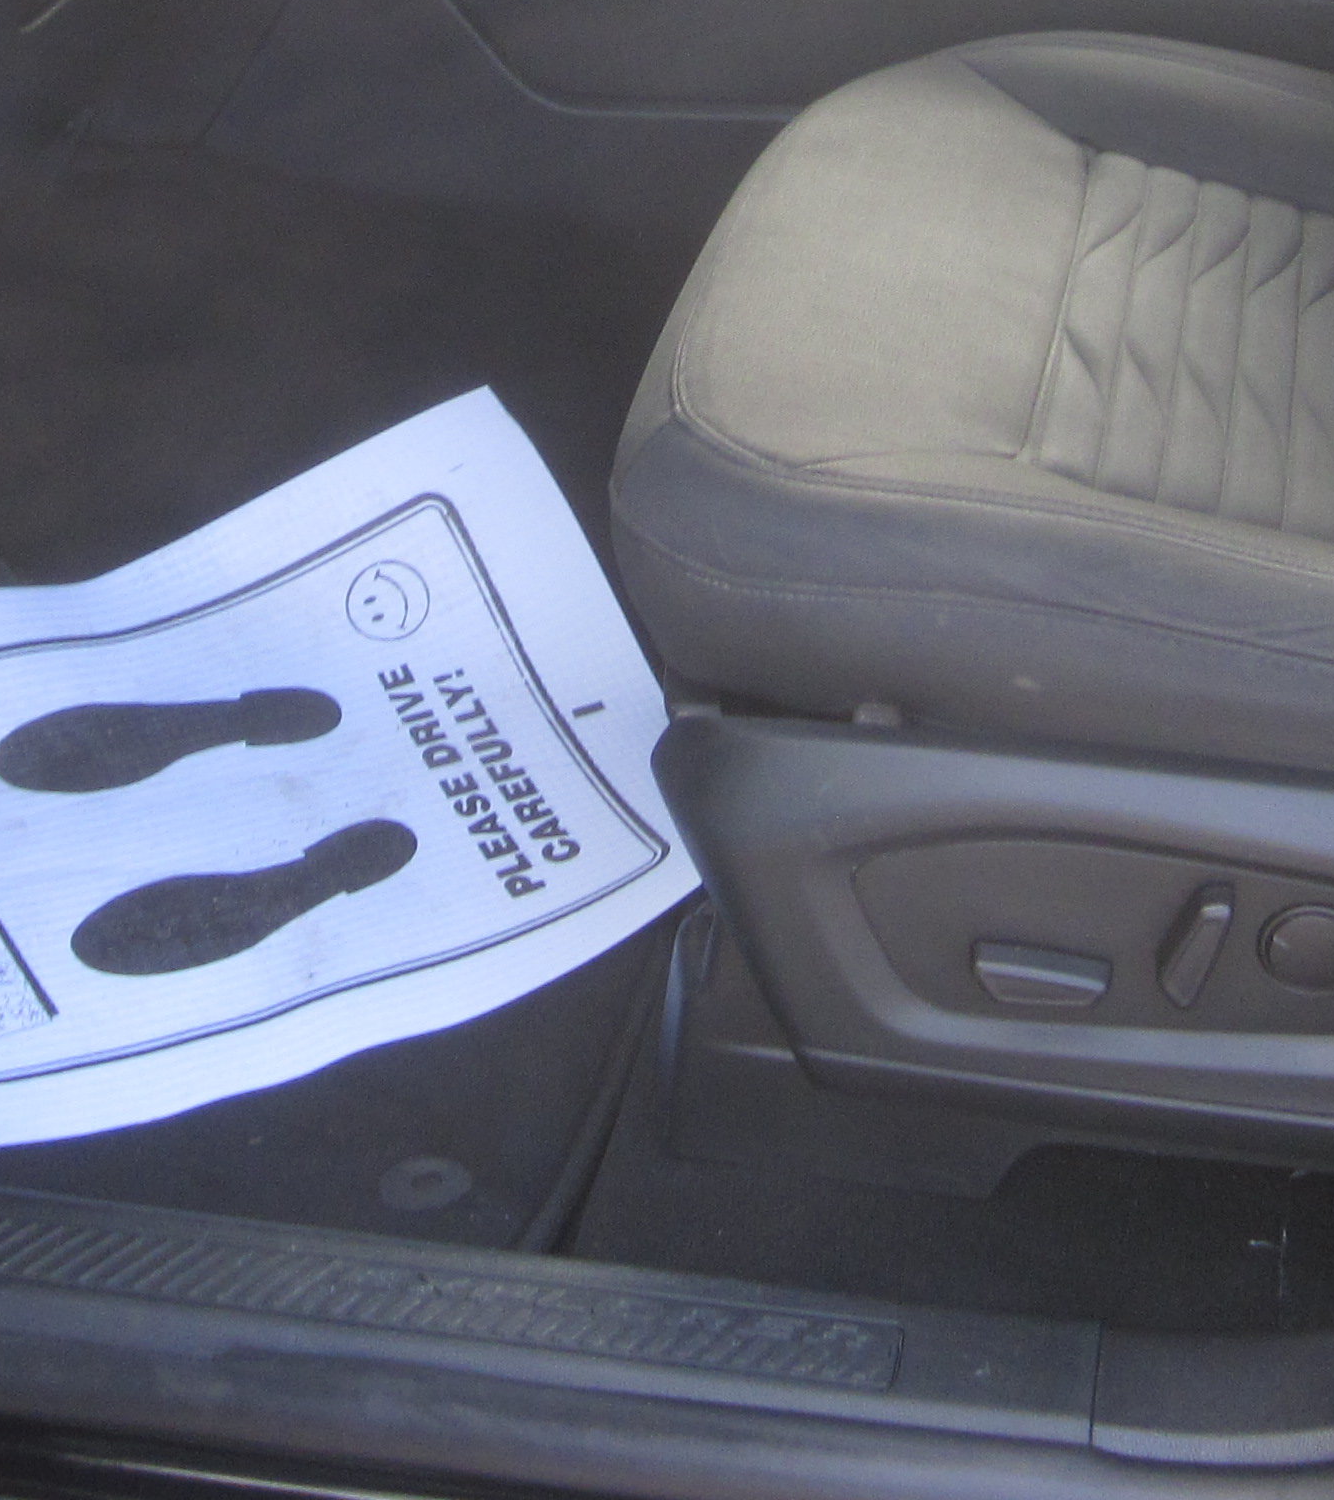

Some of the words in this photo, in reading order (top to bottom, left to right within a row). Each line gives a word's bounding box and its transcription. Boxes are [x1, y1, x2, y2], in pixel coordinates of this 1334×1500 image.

[378, 663, 463, 770] DRIVE
[433, 668, 581, 862] CAREFULLY!
[439, 772, 546, 899] PLEASE
